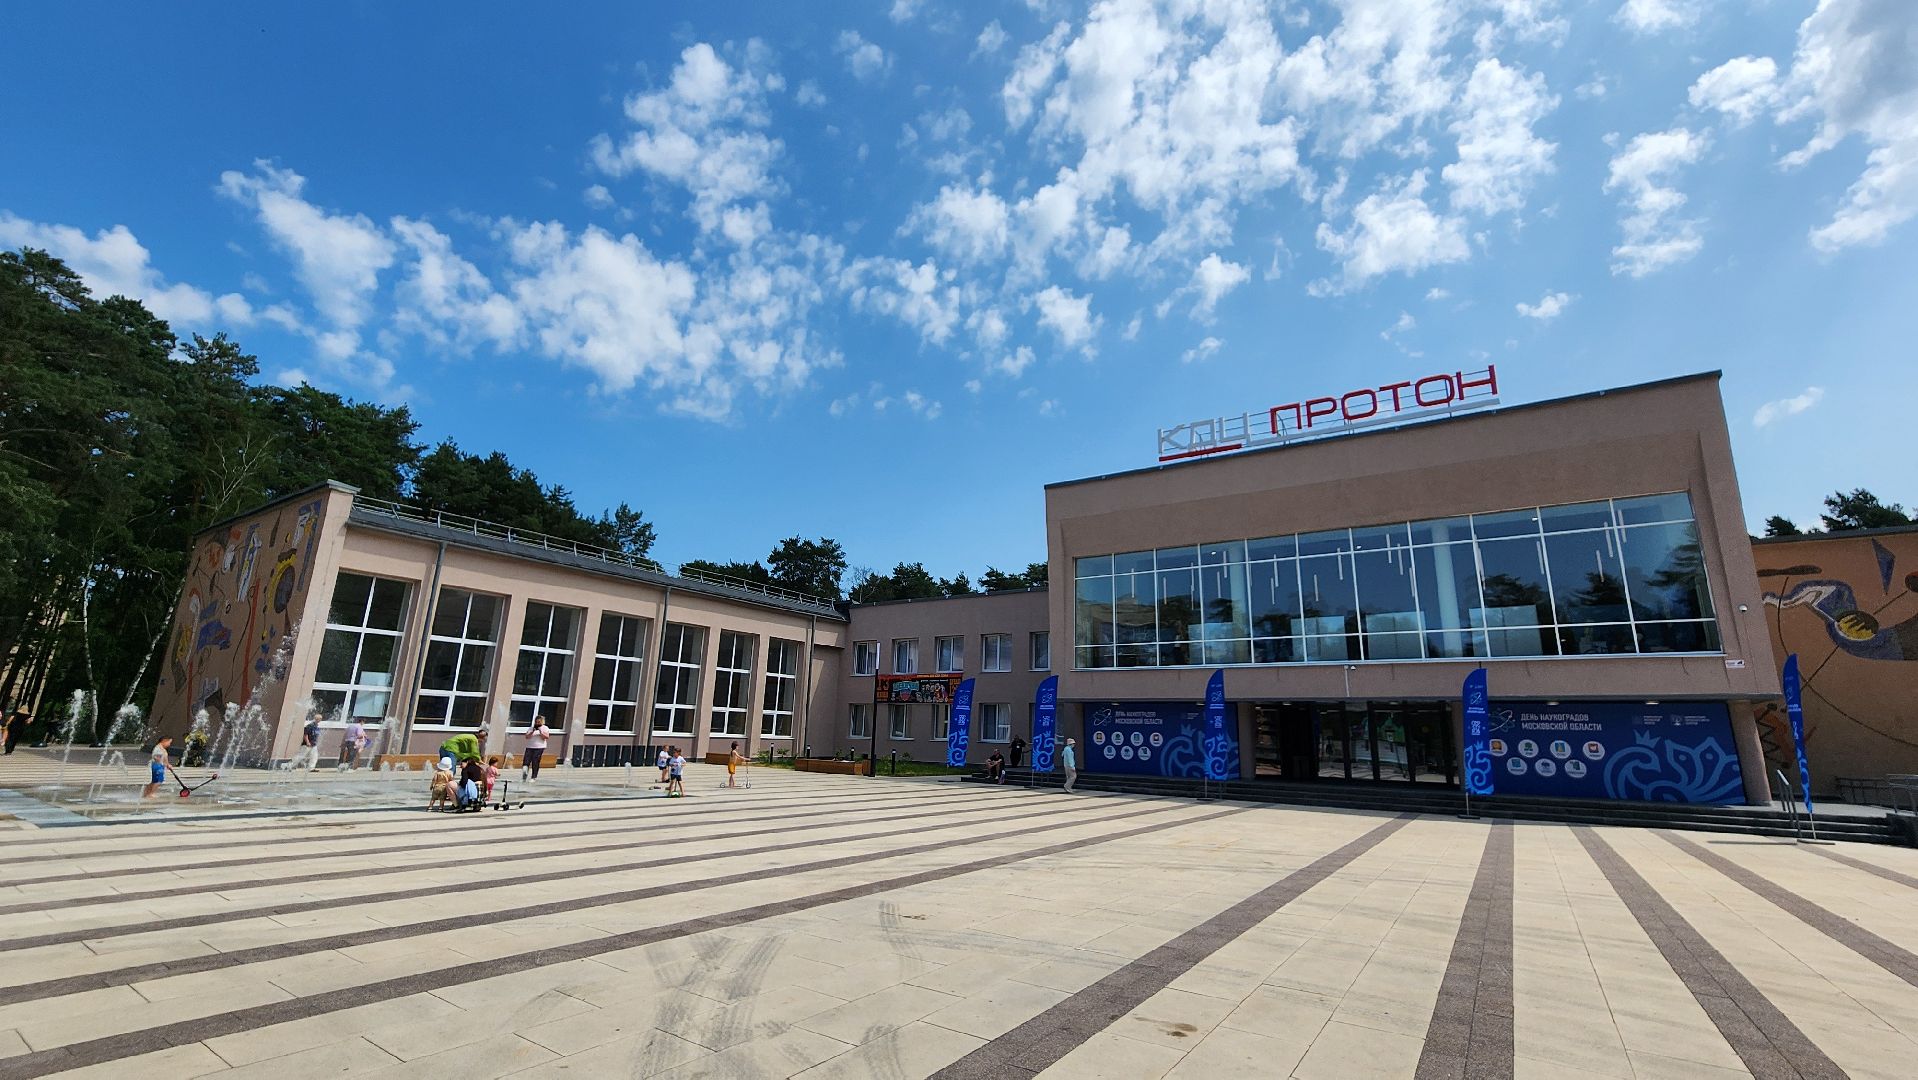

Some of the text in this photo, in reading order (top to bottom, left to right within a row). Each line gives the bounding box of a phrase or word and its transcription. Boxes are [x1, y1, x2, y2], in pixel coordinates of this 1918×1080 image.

[1157, 364, 1498, 454] КДЦ ПРОТОН
[1520, 713, 1589, 721] ДЕНЬ НАУКОГРАДОВ
[1521, 721, 1603, 731] МОСКОВСКОЙ ОБЛАСТИ
